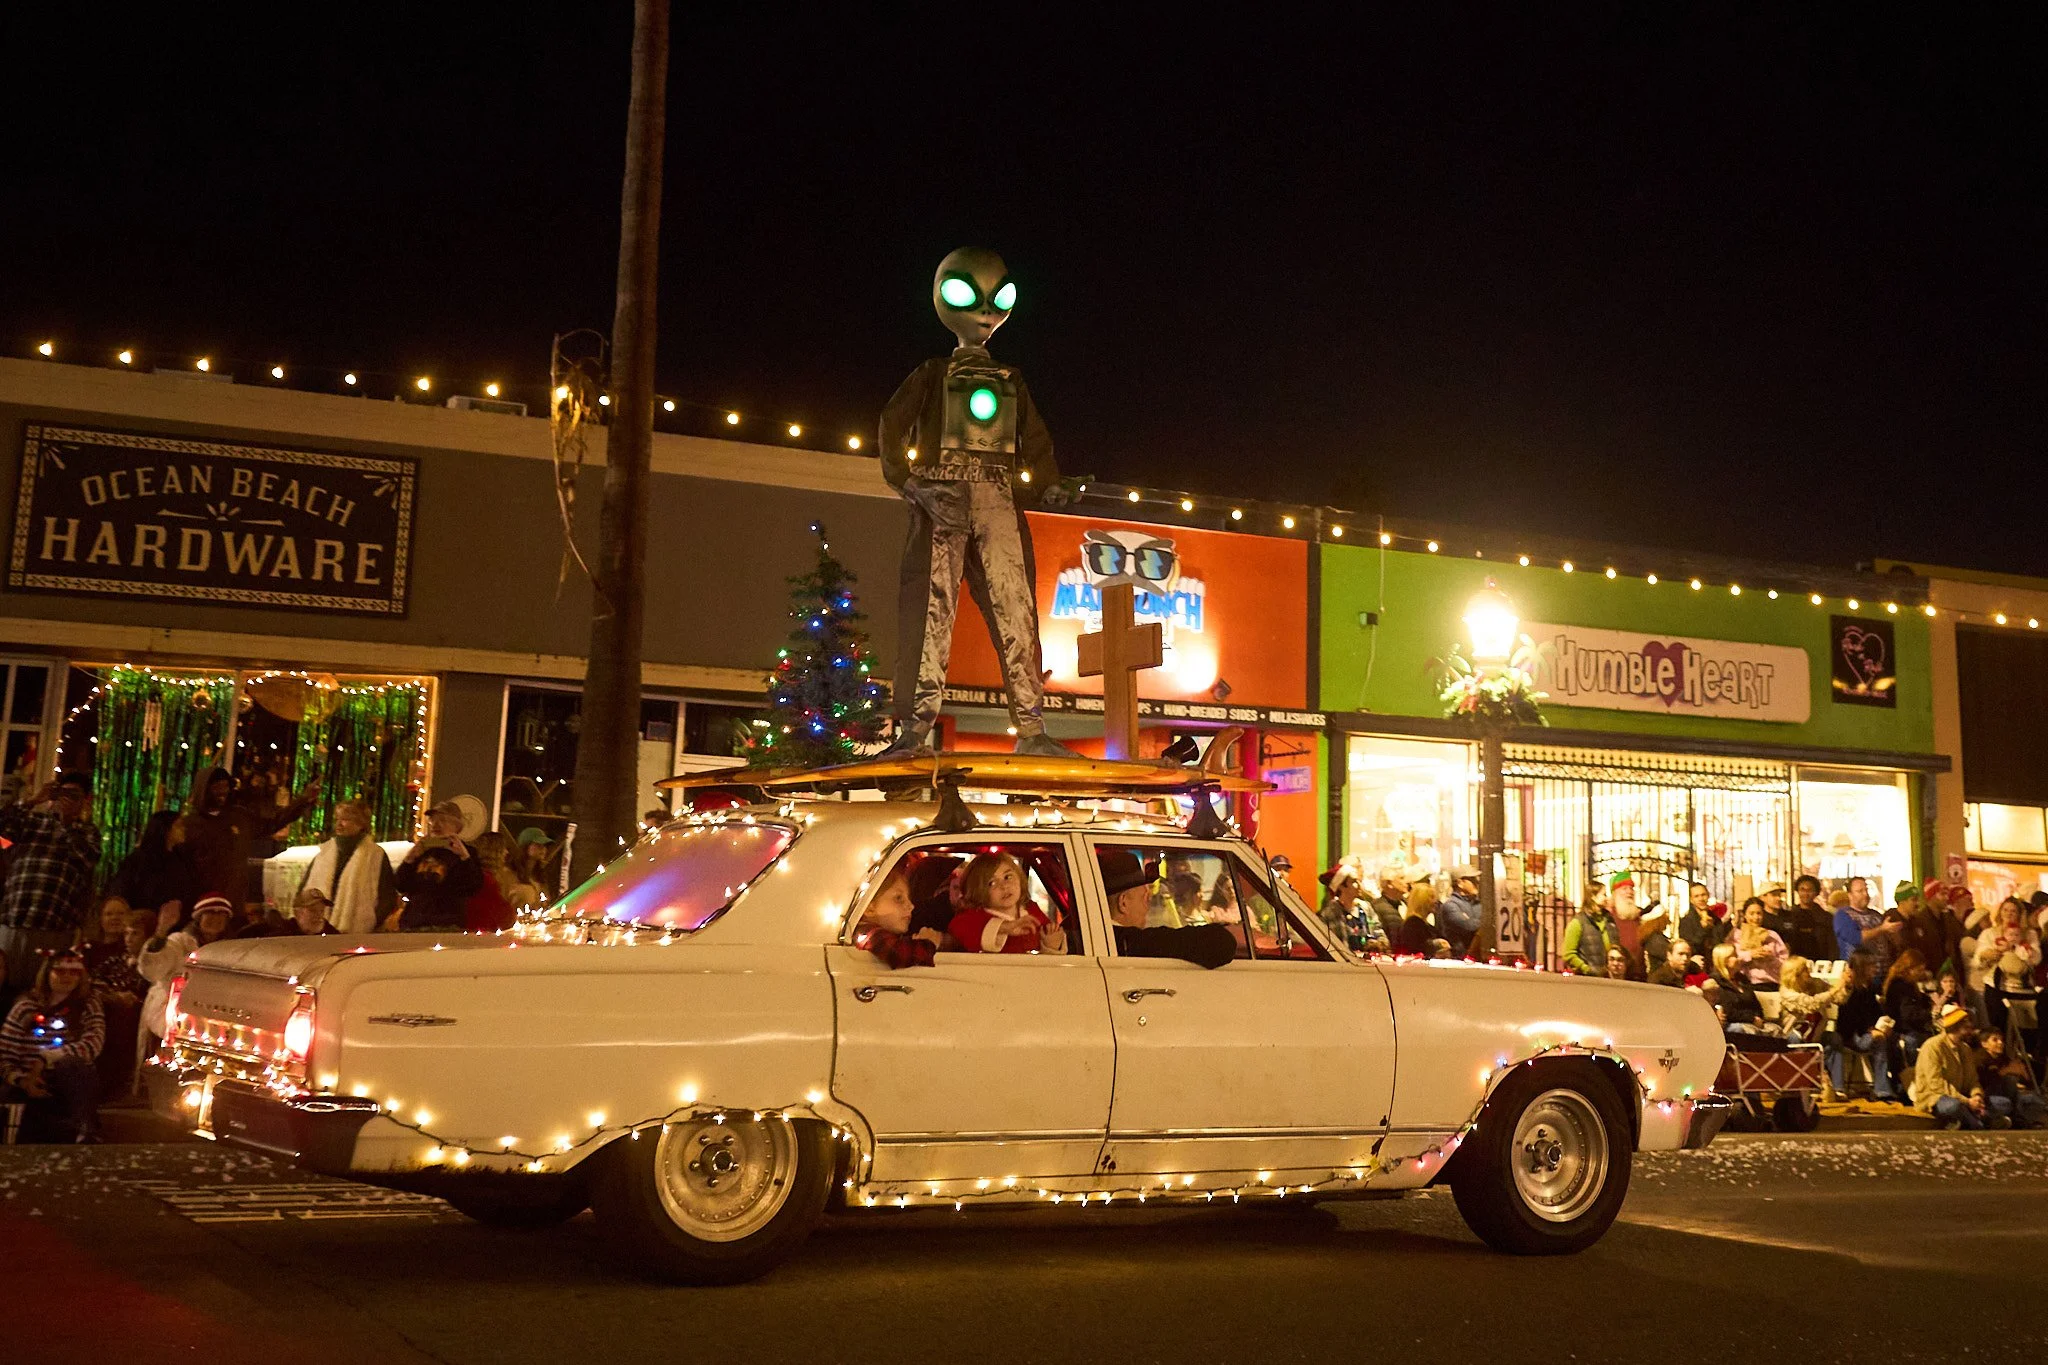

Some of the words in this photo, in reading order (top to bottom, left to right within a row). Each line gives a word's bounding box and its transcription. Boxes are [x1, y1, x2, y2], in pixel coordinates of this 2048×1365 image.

[81, 465, 213, 507] OCEAN
[231, 468, 356, 527] BEACH
[39, 516, 384, 586] HARDWARE
[1053, 583, 1103, 616] MA
[1133, 589, 1201, 630] UNCH
[1229, 708, 1258, 722] SIDES
[1269, 711, 1326, 727] MILKSHAKES
[1500, 906, 1521, 942] 20
